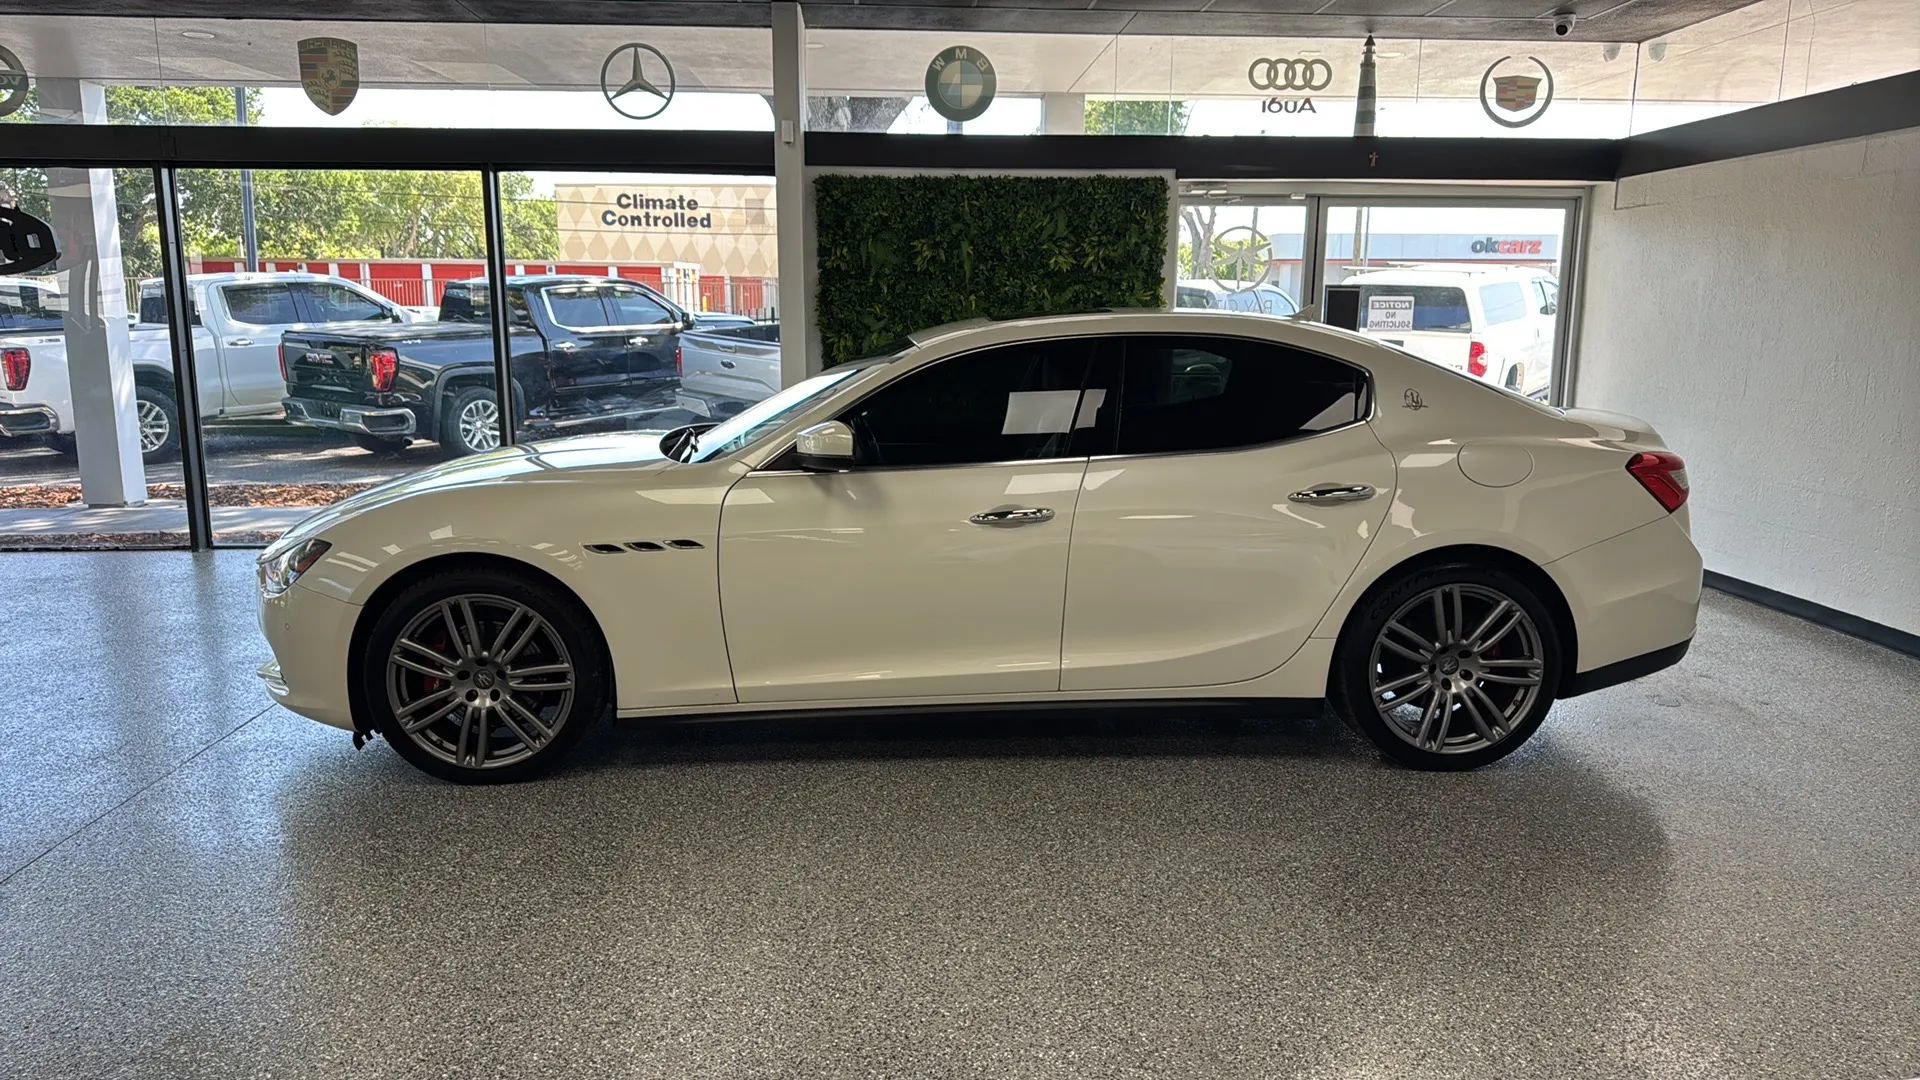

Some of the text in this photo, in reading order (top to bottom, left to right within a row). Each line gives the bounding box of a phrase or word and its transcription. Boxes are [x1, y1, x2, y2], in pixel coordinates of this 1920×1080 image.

[616, 193, 699, 210] Climate
[601, 210, 712, 228] Controlled
[1471, 237, 1542, 254] okcarz
